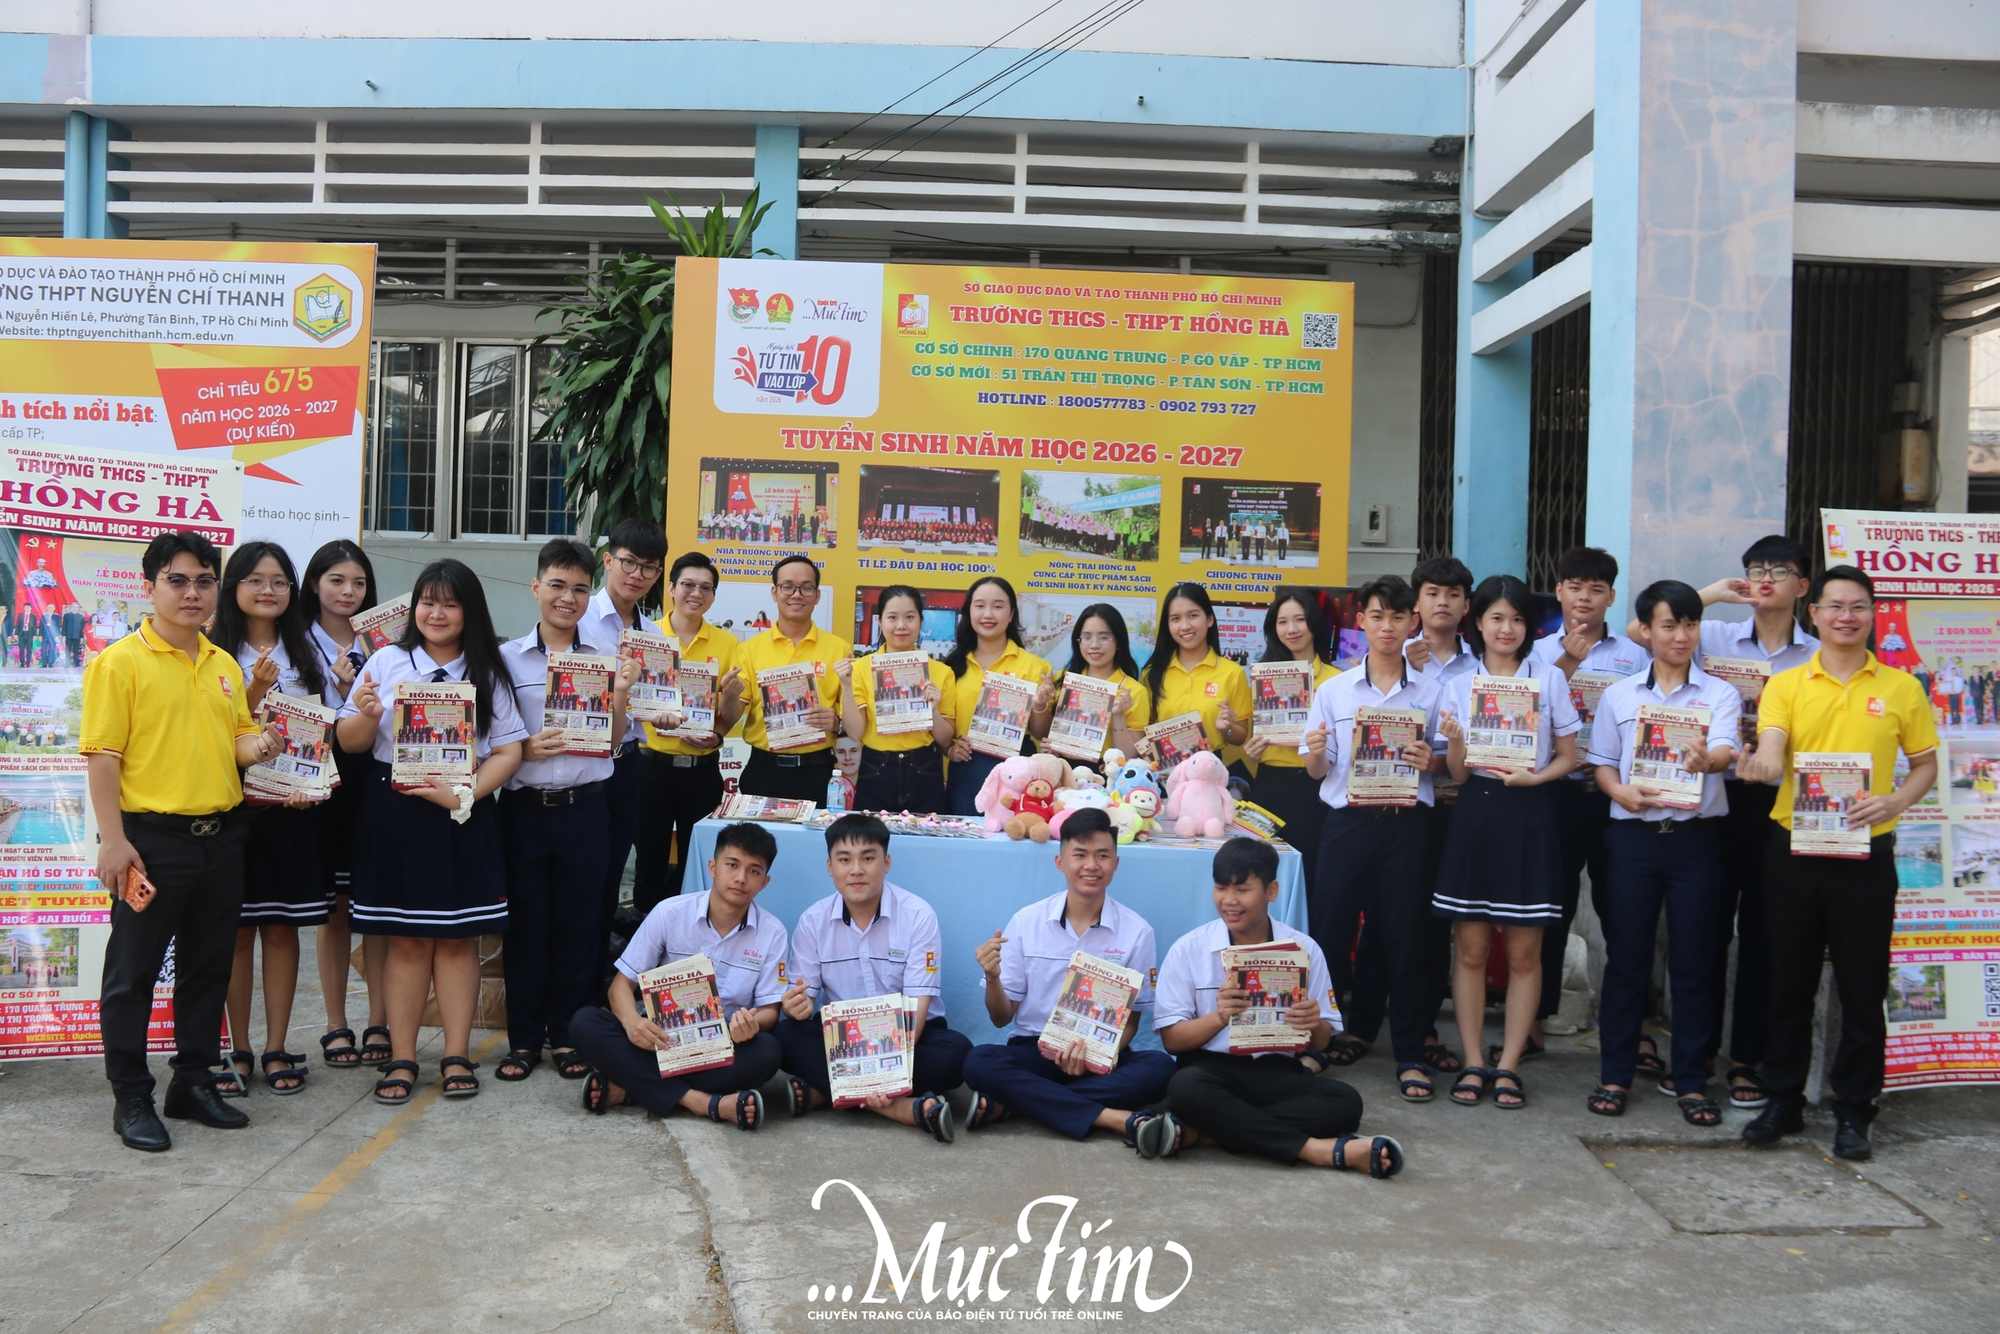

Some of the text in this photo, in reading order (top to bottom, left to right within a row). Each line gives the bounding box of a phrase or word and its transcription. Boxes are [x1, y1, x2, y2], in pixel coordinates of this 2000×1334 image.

[7, 265, 285, 285] DỤC VÀ ĐÀO TẠO THÀNH PHỐ HỒ CHÍ MINH
[39, 286, 86, 302] THPT
[91, 282, 172, 304] NGUYỄN
[178, 286, 212, 305] CHÍ
[217, 291, 285, 307] THANH
[964, 281, 1283, 306] SỞ GIÁO DỤC ĐÀO VÀ TẠO THÀNH PHỐ HỒ CHÍ MINH
[6, 309, 289, 327] Nguyễn Hiến Lê, Phường Tân Bình, TP Hồ Chí Minh
[950, 305, 1290, 336] TRƯỜNG THCS THPT HỒNG HÀ
[47, 327, 234, 341] thptnguyenchithanh.hcm.edu.vn
[759, 353, 801, 371] TỰ TIN
[915, 340, 1322, 371] CƠ SỞ CHÍNH 170 QUANG TRUNG P.GÒ VẤP TP.HCM
[764, 373, 807, 389] VÀO LỚP
[796, 335, 851, 405] 10
[911, 364, 932, 377] CƠ
[935, 363, 956, 378] SỞ
[959, 365, 991, 379] MỚI
[1001, 369, 1017, 380] 51
[1070, 371, 1097, 386] THỊ
[1101, 373, 1156, 388] TRỌNG
[1169, 375, 1216, 389] P.TÂN
[1220, 377, 1252, 390] SƠN
[1265, 380, 1324, 394] TP.HCM
[198, 367, 313, 399] CHỈ TIÊU 675
[23, 398, 110, 421] tích nổi
[181, 400, 338, 425] NĂM HỌC 2026 2027
[977, 392, 1257, 415] HOTLINE 1800577783 0902 793 727
[226, 419, 295, 443] (DỰ KIẾN)
[781, 422, 1244, 468] TUYỂN SINH NĂM HỌC 2026 2027
[100, 466, 145, 483] THCS
[163, 472, 209, 488] THPT
[0, 475, 223, 521] HỒNG HÀ
[258, 507, 340, 522] thao học sinh
[23, 515, 61, 528] SINH
[65, 516, 104, 534] NĂM
[107, 523, 137, 539] HỌC
[1929, 529, 1963, 542] THCS
[941, 562, 964, 573] HỌC
[967, 563, 996, 573] 100%
[1855, 540, 1962, 573] HỒNG
[1210, 582, 1232, 591] ANH
[1873, 580, 1995, 594] SINH NĂM HỌC 2026
[44, 869, 63, 877] SƠ
[38, 893, 107, 906] TUYỂN
[2, 916, 26, 925] HỌC
[5, 1003, 84, 1013] 170 QUANG TRUNG
[26, 1033, 65, 1041] WEBSITE
